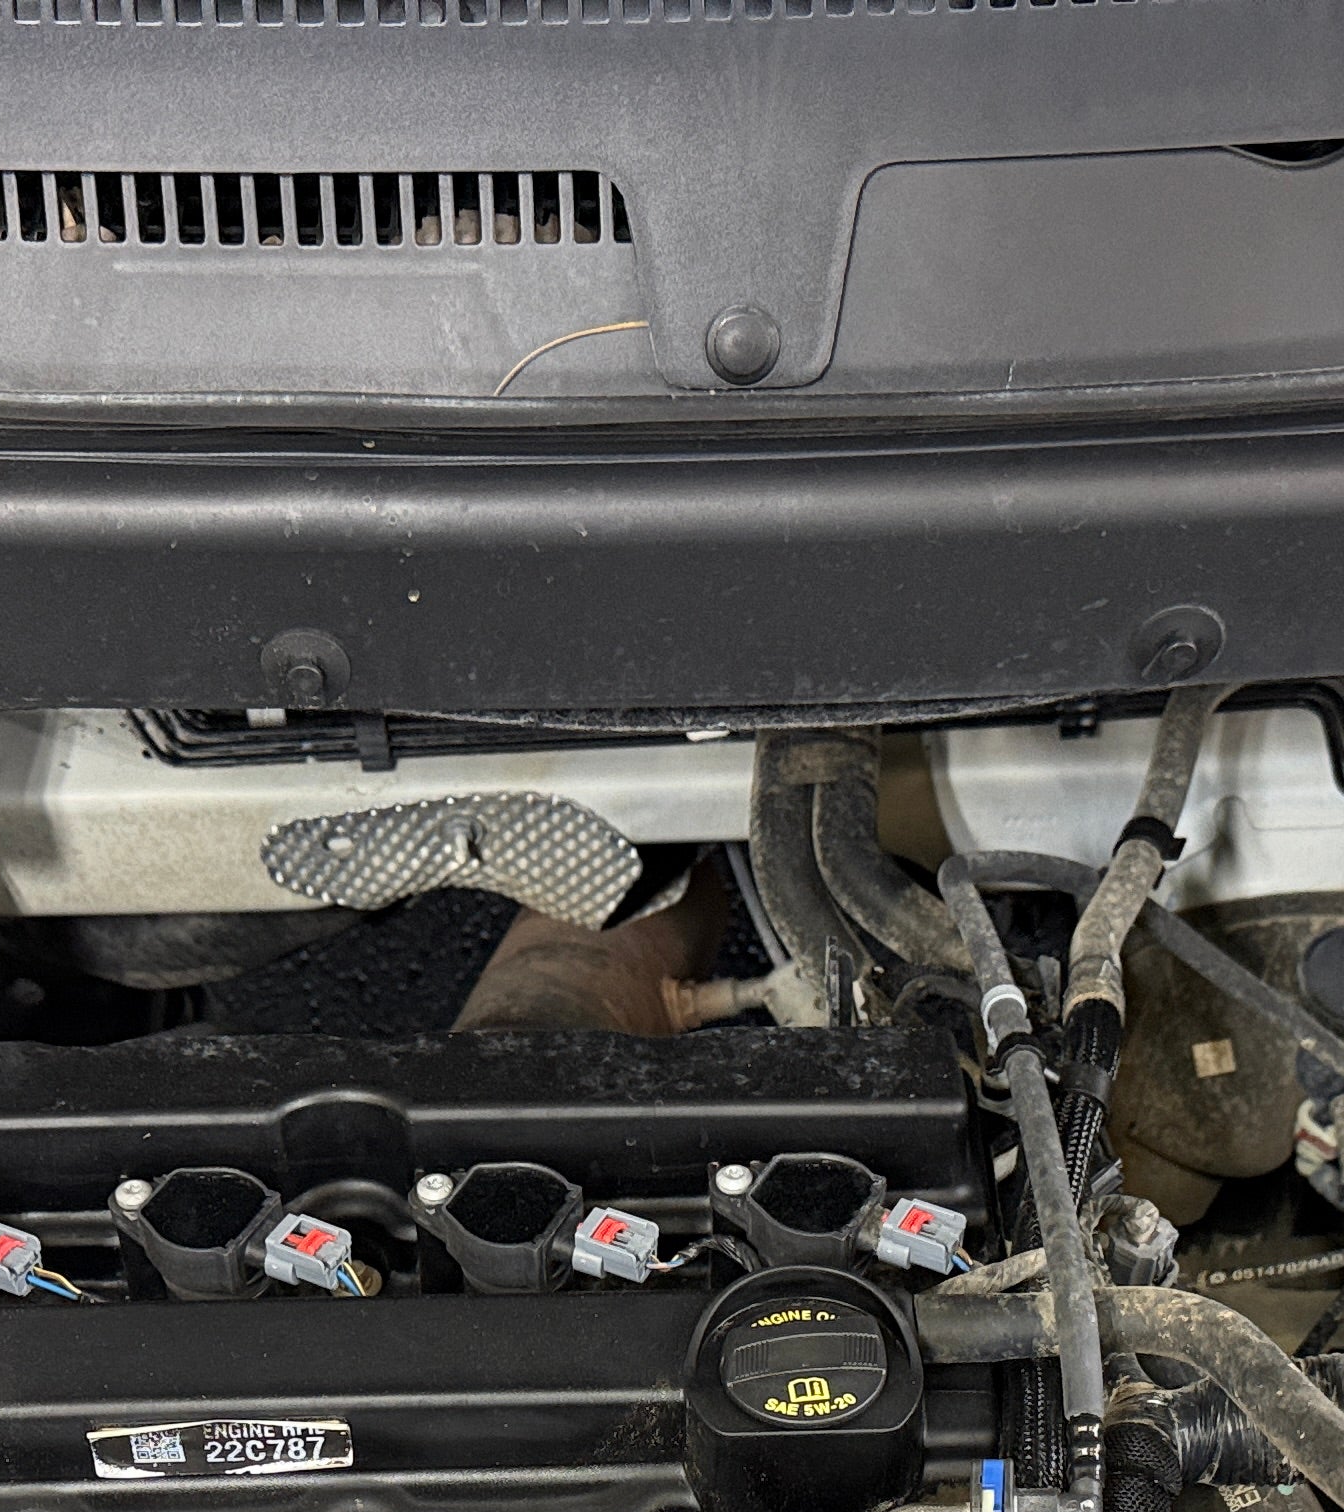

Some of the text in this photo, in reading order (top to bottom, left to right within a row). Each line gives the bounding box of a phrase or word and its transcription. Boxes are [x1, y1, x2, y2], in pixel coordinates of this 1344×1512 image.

[750, 1309, 812, 1328] NGINE
[764, 1392, 857, 1417] SAE 5W-20
[202, 1422, 276, 1440] ENGINE
[204, 1436, 325, 1463] 22C787
